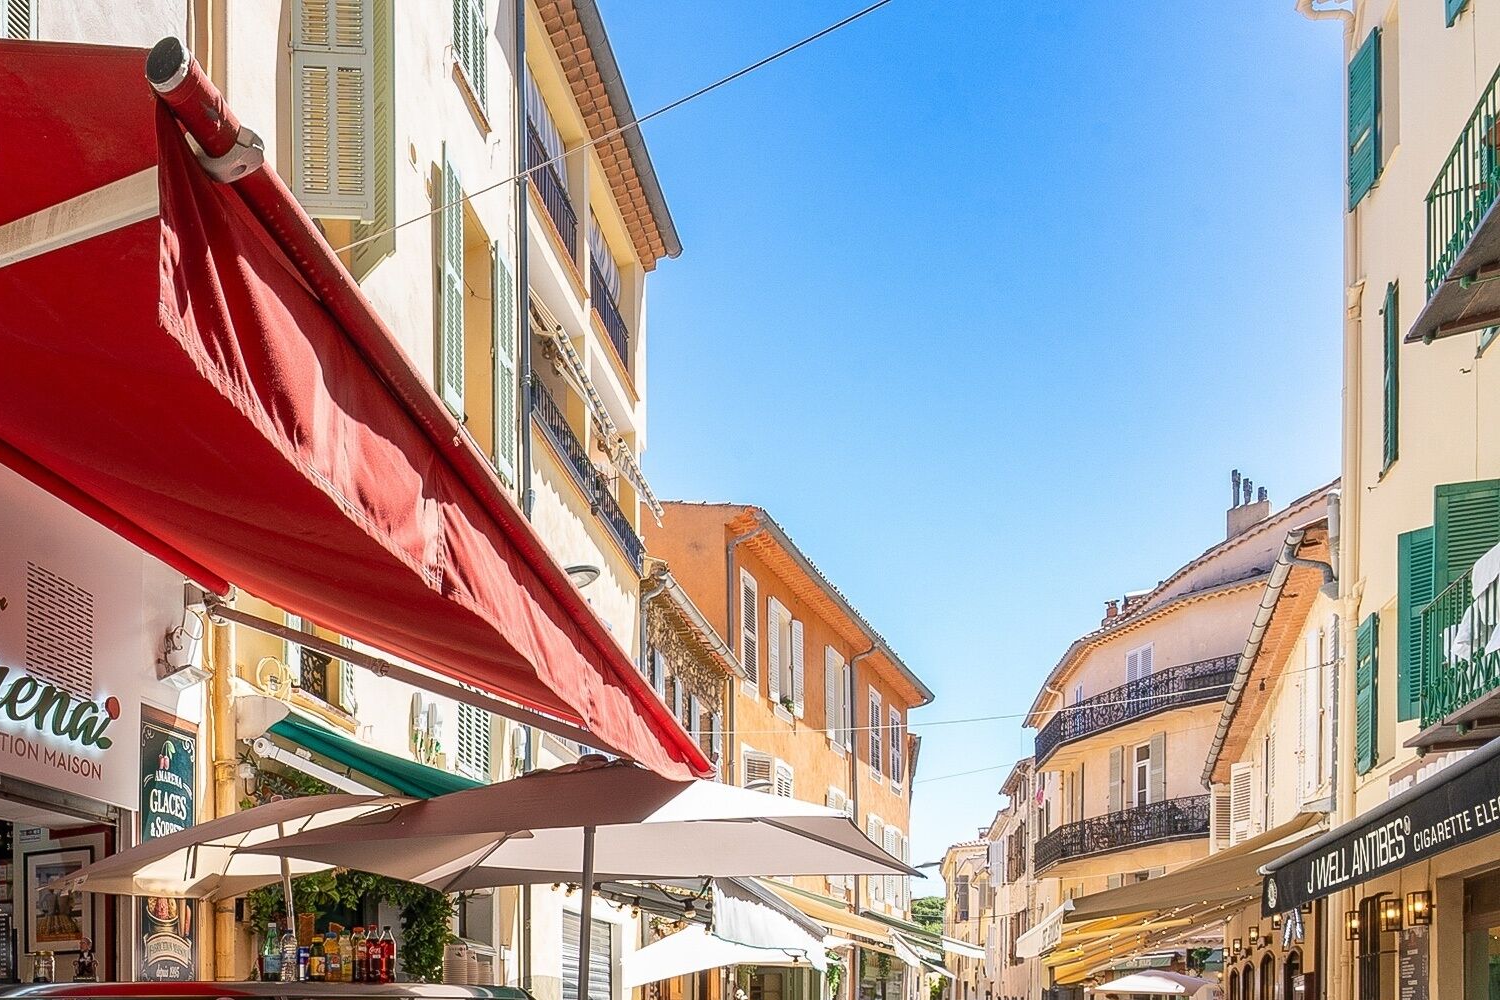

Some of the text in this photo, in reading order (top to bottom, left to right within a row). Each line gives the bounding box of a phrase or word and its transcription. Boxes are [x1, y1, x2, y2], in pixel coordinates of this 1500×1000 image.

[44, 745, 102, 780] MAISON
[155, 770, 182, 788] AMARENA
[150, 789, 187, 820] GLACES
[150, 822, 156, 836] &
[1414, 810, 1472, 852] CIGARETTE
[1308, 861, 1314, 894] J
[1316, 848, 1350, 890] WELL
